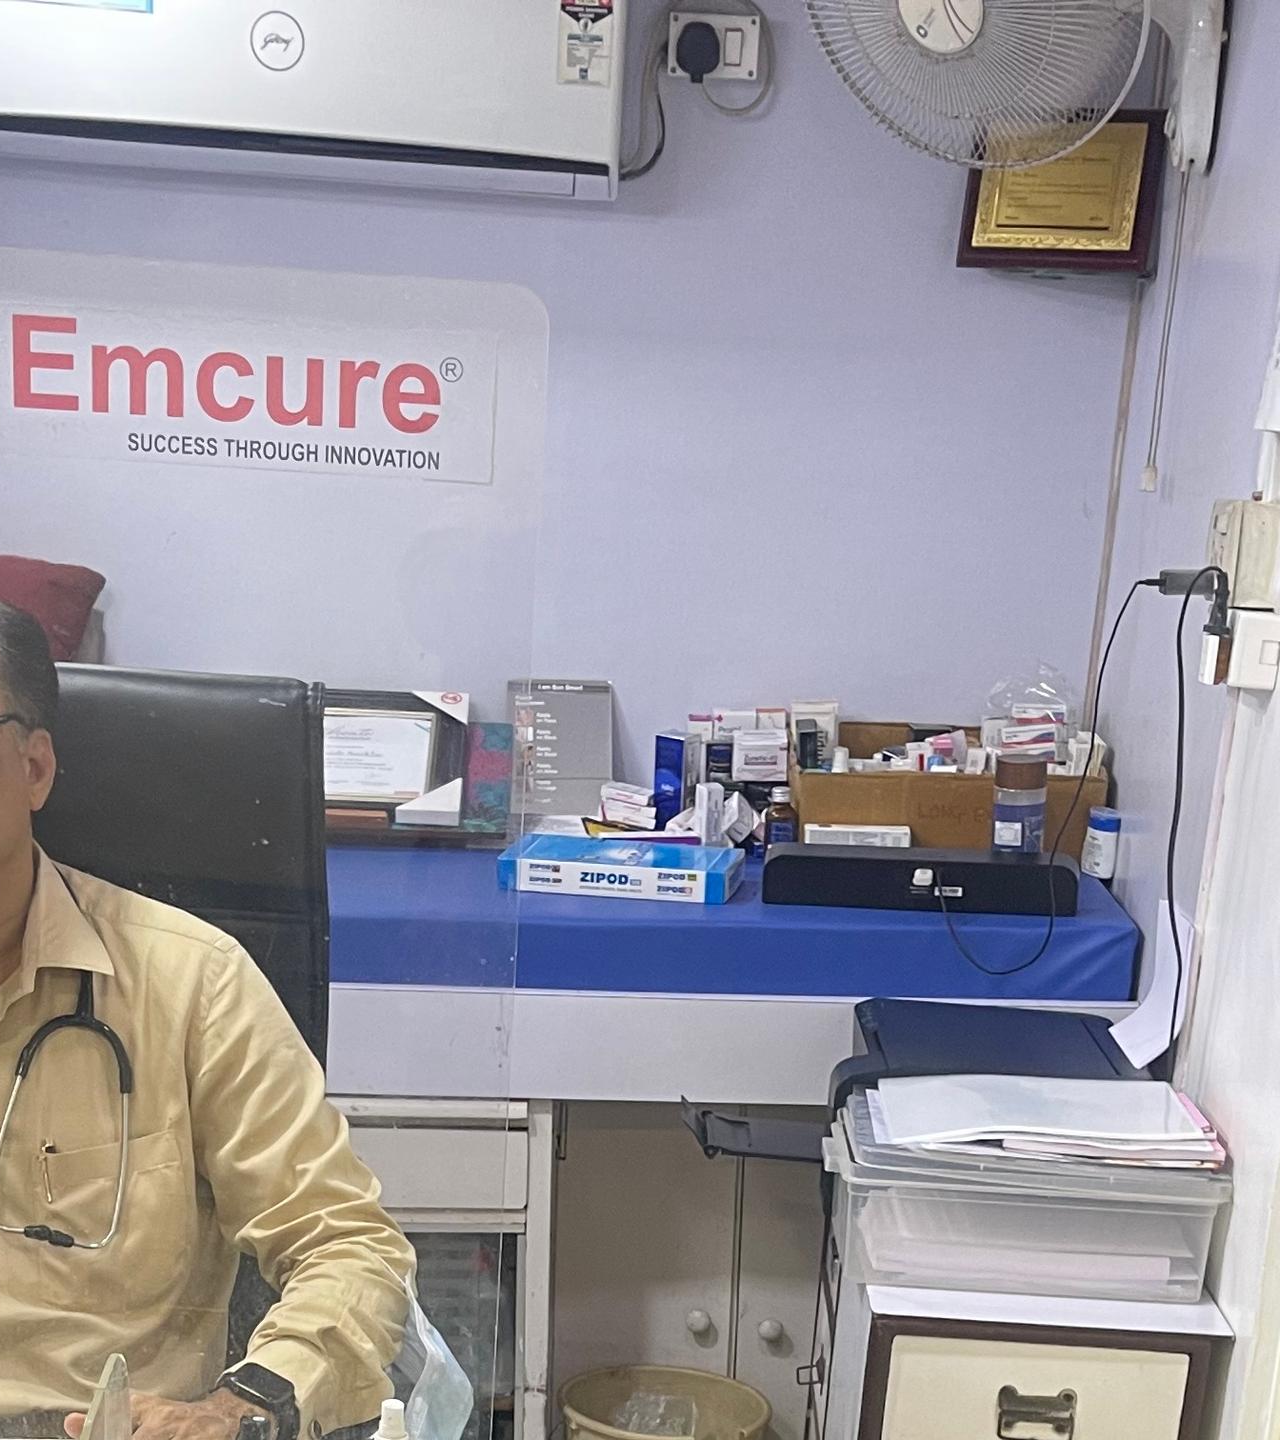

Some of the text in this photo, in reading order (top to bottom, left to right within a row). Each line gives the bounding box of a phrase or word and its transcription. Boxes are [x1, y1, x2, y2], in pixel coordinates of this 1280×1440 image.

[12, 313, 442, 434] Emcure
[127, 432, 441, 471] SUCCESS THROUGH INNOVATION
[580, 871, 629, 886] ZIPOD
